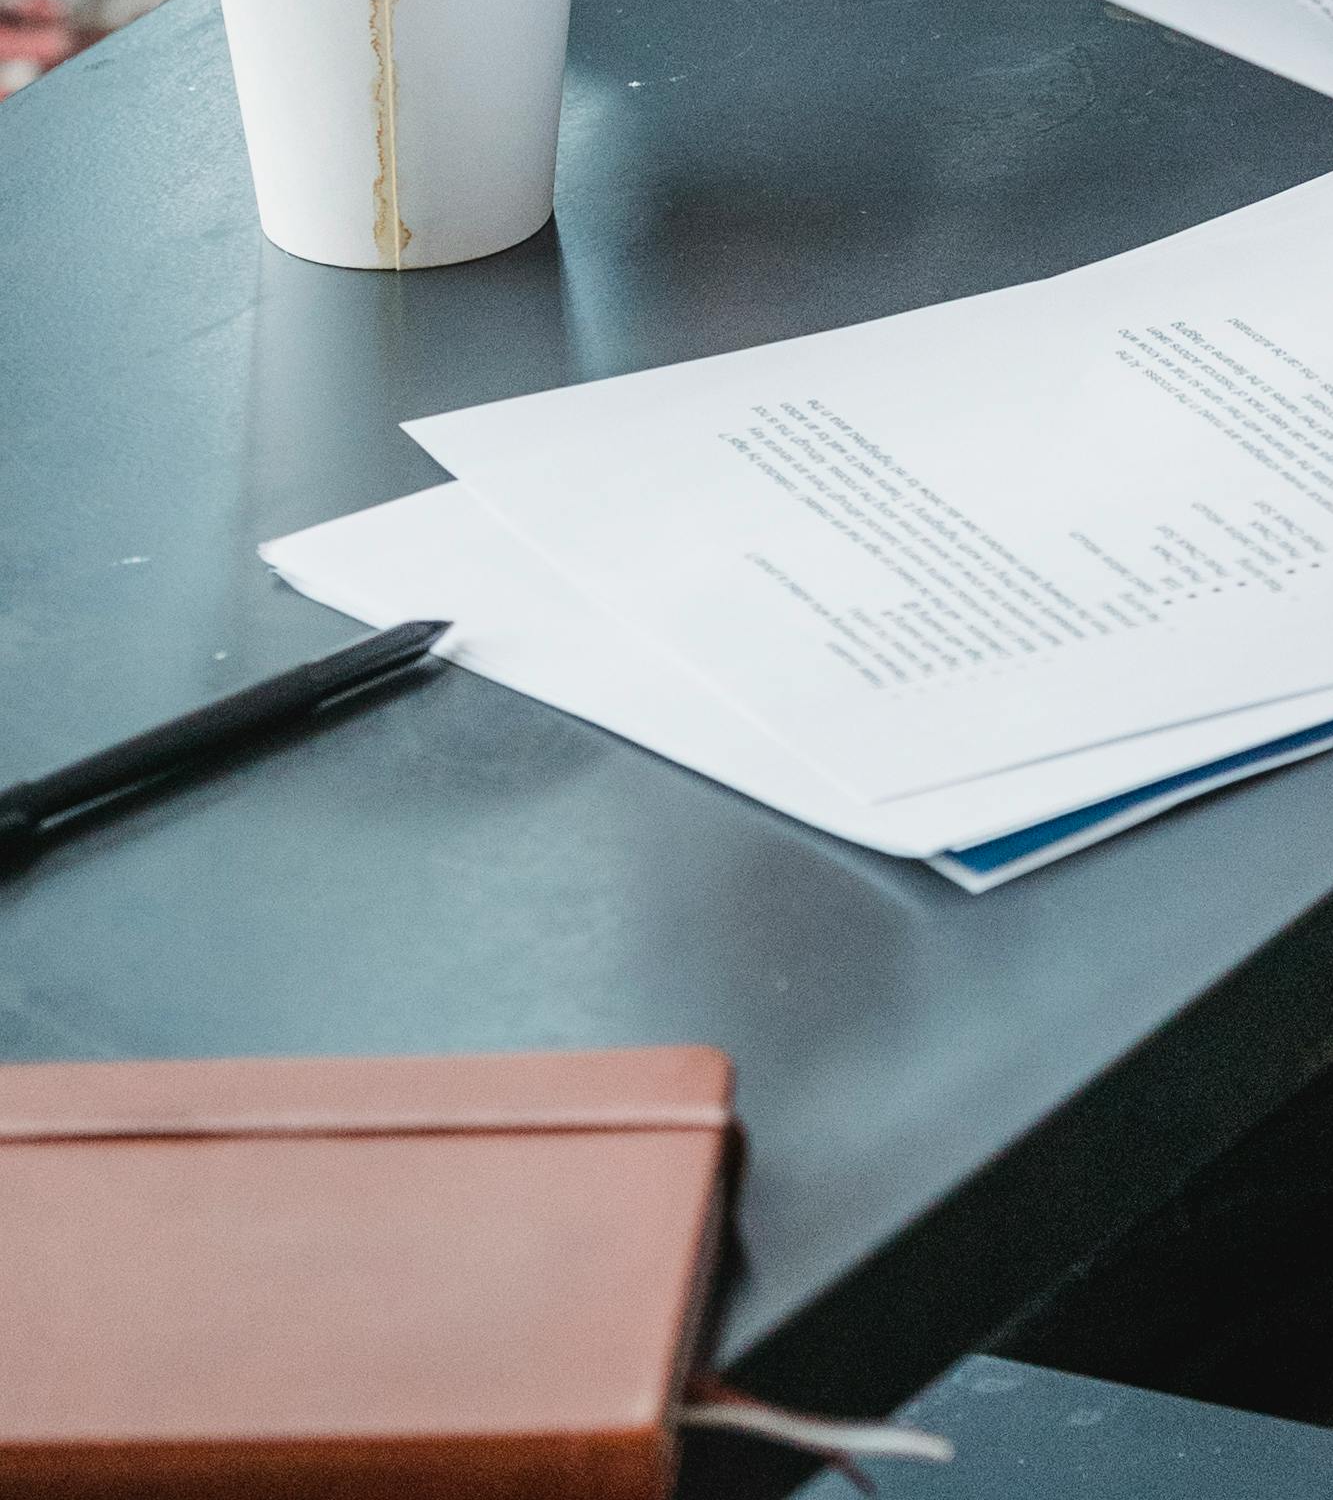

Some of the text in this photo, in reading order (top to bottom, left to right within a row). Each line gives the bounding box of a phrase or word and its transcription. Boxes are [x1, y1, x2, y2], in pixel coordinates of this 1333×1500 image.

[1116, 327, 1141, 342] who
[1145, 325, 1175, 344] taken
[1170, 320, 1206, 344] tagging
[1114, 349, 1134, 361] the
[1168, 342, 1203, 364] actions
[749, 404, 772, 417] not
[779, 401, 808, 422] action
[806, 398, 826, 411] the
[775, 423, 796, 437] this
